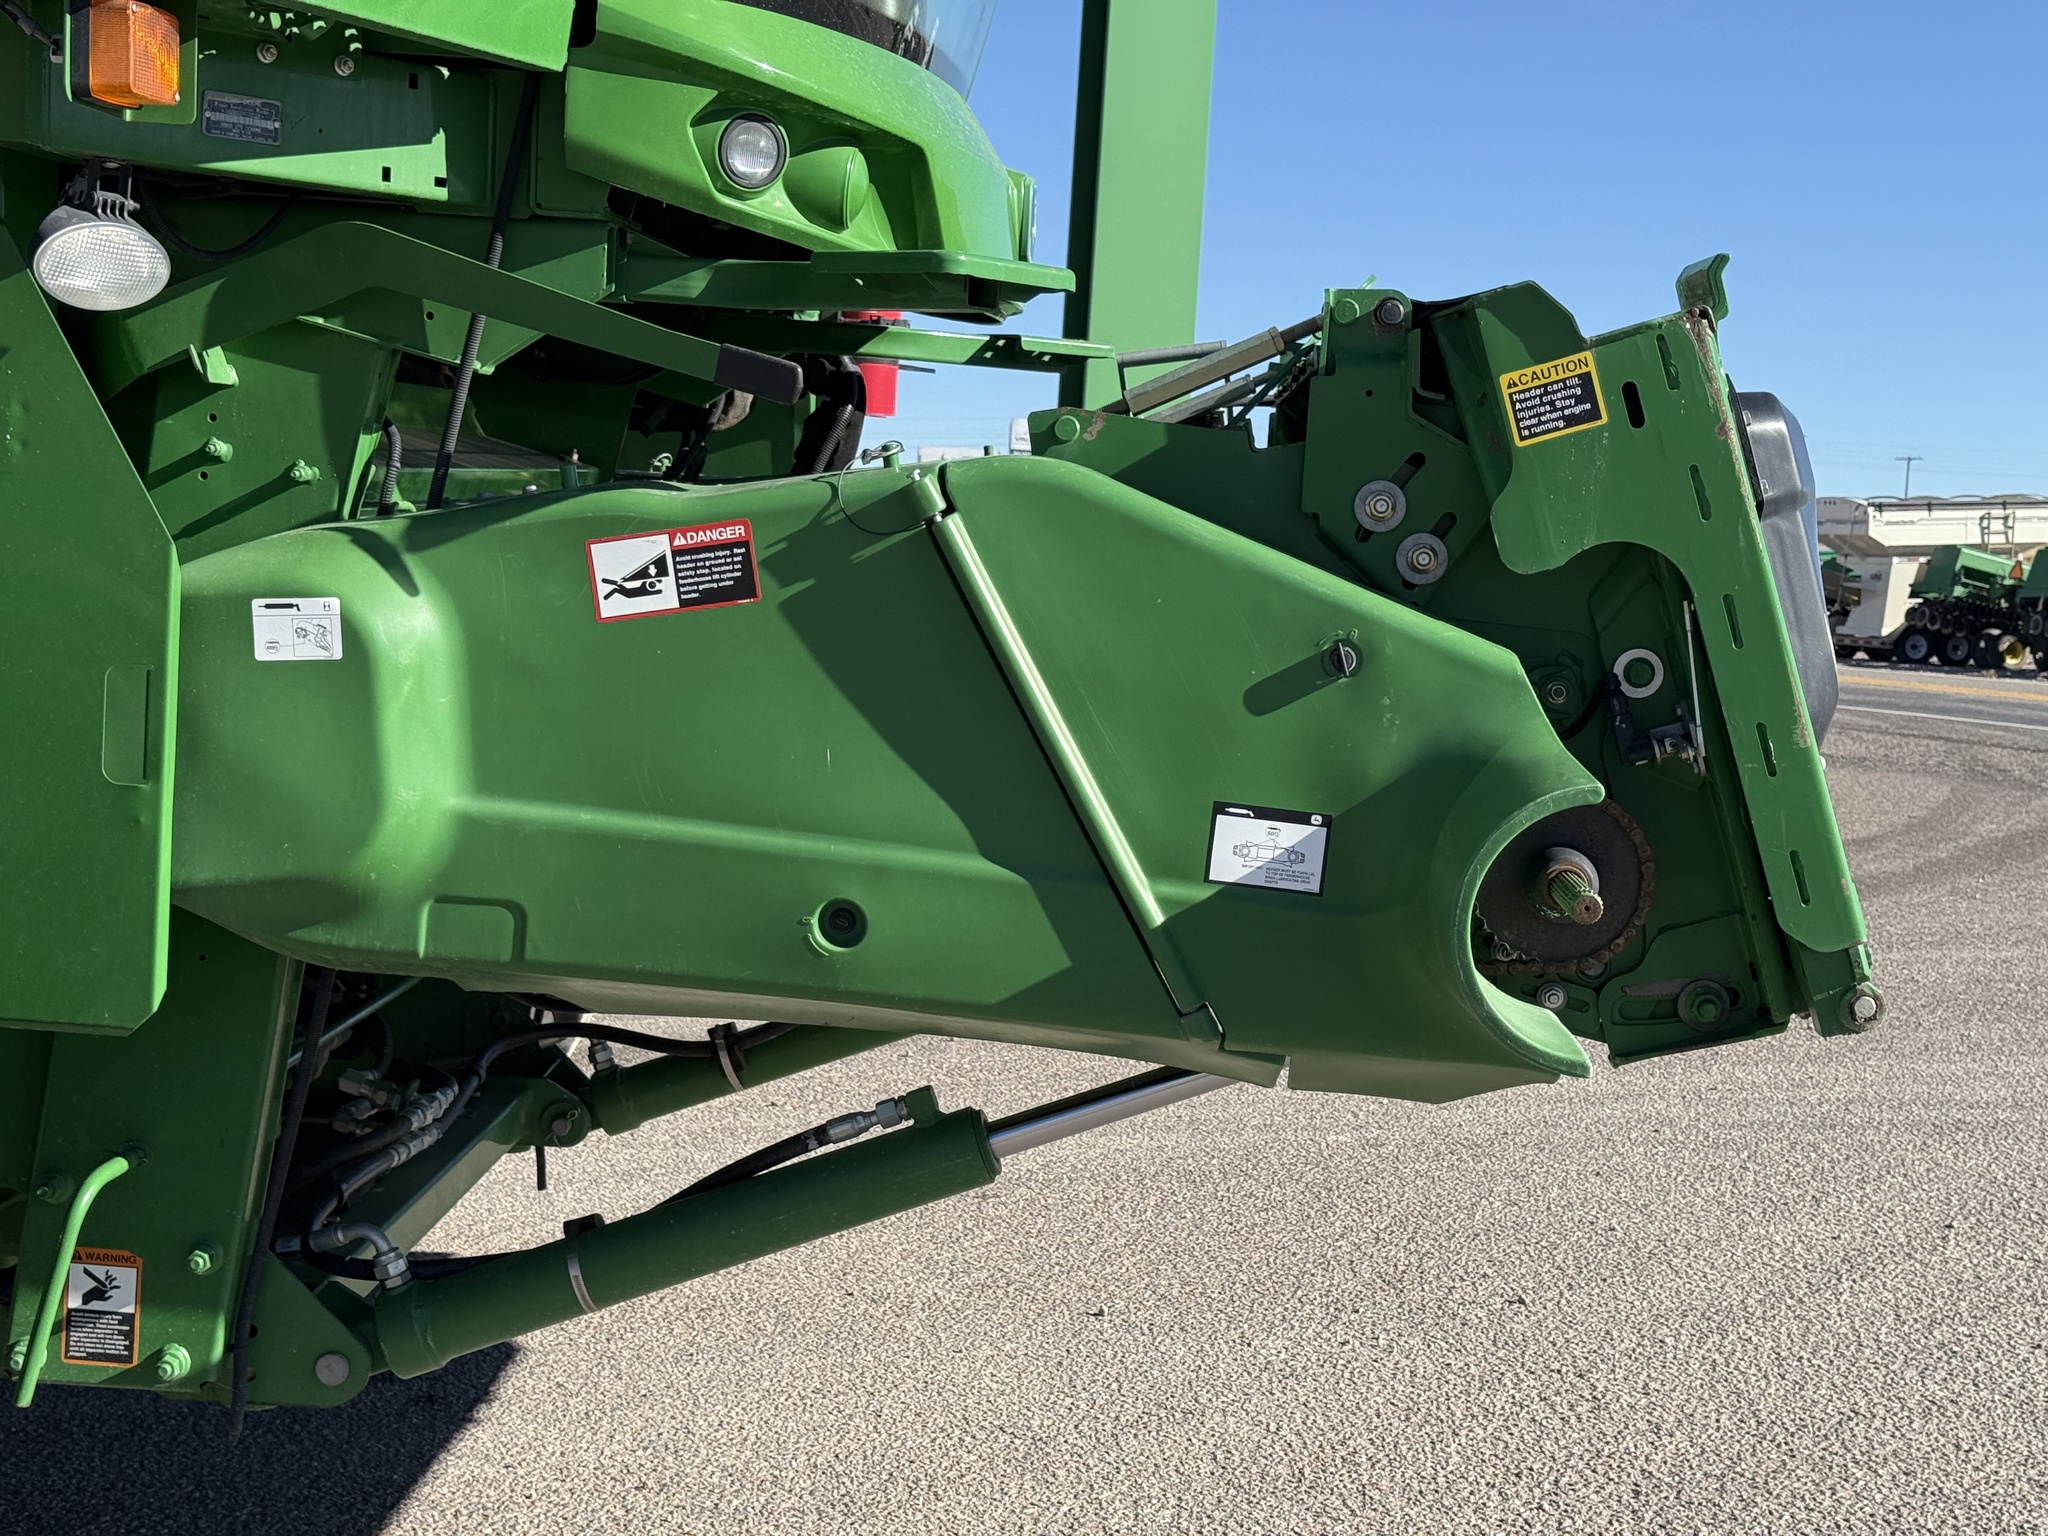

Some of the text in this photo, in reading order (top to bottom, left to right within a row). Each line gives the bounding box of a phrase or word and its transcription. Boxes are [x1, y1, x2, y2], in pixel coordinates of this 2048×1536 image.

[1519, 356, 1589, 385] CAUTION
[1512, 377, 1582, 401] Header can tilt.
[1515, 387, 1581, 410] Avoid crushing
[1517, 398, 1575, 419] injuries. Stay
[1519, 403, 1591, 427] clear when engine
[1531, 419, 1566, 433] running.
[687, 525, 745, 544] DANGER
[705, 558, 725, 566] ground
[721, 571, 742, 579] cylinder
[85, 1252, 137, 1264] WARNING
